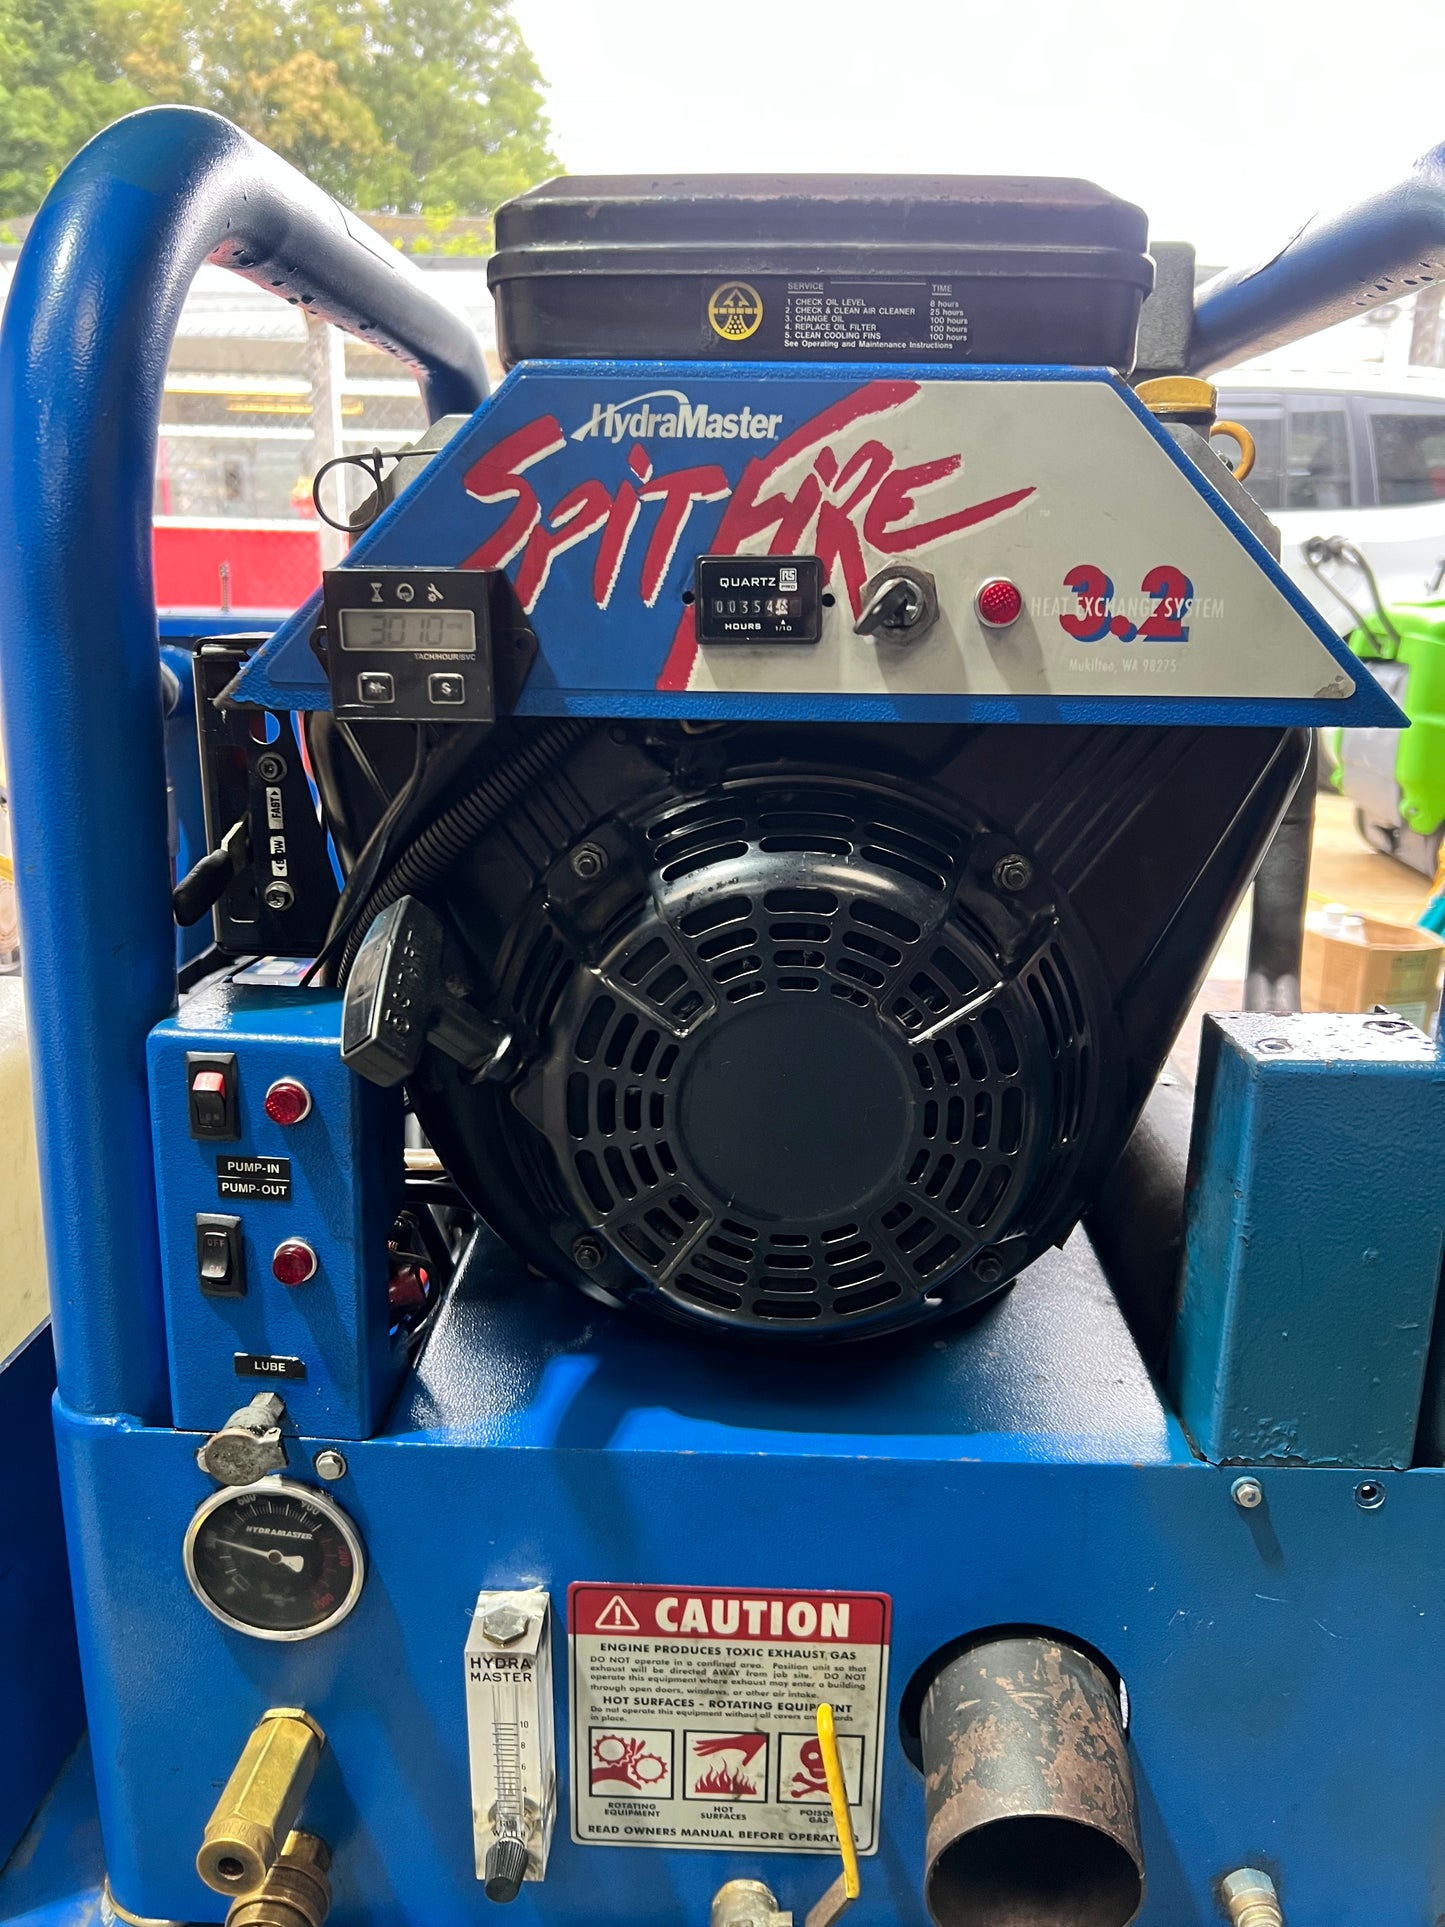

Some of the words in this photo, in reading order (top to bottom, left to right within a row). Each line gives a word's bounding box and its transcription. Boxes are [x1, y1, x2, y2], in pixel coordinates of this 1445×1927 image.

[787, 282, 824, 290] SERVICE
[931, 284, 952, 293] TIME
[795, 298, 823, 306] CHECK
[825, 298, 839, 306] OIL
[929, 300, 935, 308] 8
[937, 300, 959, 308] hours
[833, 307, 860, 315] CLEAN
[863, 307, 876, 315] AIR
[878, 308, 916, 316] CLEANER
[930, 308, 941, 316] 25
[785, 315, 792, 323] 3.
[795, 315, 828, 323] CHANGE
[930, 317, 945, 325] 100
[946, 317, 968, 325] hours
[795, 323, 831, 331] REPLACE
[930, 325, 944, 333] 100
[946, 325, 967, 333] hours
[823, 332, 860, 340] COOLING
[863, 332, 881, 340] FINS
[930, 333, 944, 341] 100
[946, 334, 967, 342] hours
[784, 340, 799, 348] See
[801, 340, 839, 349] Operating
[841, 340, 856, 348] and
[859, 341, 907, 349] Maintenance
[909, 341, 953, 350] Instructions
[588, 400, 783, 444] HydraMaster
[781, 570, 796, 582] RS
[720, 577, 776, 588] QUARTZ
[1031, 597, 1071, 618] HEAT
[1075, 597, 1158, 618] EXCHANGE
[1163, 597, 1225, 618] SYSTEM
[1059, 564, 1194, 643] 3.2
[414, 653, 476, 661] TACH/HOUR/SVC
[1069, 657, 1118, 674] Mukilteo,
[1122, 658, 1139, 673] WA
[1142, 658, 1177, 673] 98275
[270, 797, 281, 819] FAST
[227, 1161, 280, 1174] PUMP-IN
[221, 1182, 287, 1195] PUMP-OUT
[254, 1361, 287, 1373] LUBE
[245, 1526, 314, 1540] HYDRAMASTER
[655, 1597, 850, 1638] CAUTION
[600, 1643, 649, 1652] ENGINE
[654, 1644, 721, 1655] PRODUCES
[726, 1647, 763, 1657] TOXIC
[768, 1648, 826, 1659] EXHAUST
[830, 1651, 856, 1660] GAS
[470, 1657, 532, 1669] HYDRA
[609, 1656, 630, 1664] NOT
[635, 1658, 670, 1667] operate
[674, 1658, 682, 1666] in
[697, 1659, 736, 1668] confined
[773, 1663, 808, 1671] Position
[813, 1663, 830, 1671] unit
[470, 1672, 532, 1682] MASTER
[590, 1664, 625, 1672] exhaust
[670, 1667, 706, 1675] directed
[712, 1668, 740, 1676] AWAY
[746, 1669, 767, 1677] from
[773, 1670, 787, 1679] job
[845, 1673, 866, 1681] NOT
[590, 1673, 625, 1681] operate
[648, 1675, 697, 1684] equipment
[700, 1677, 728, 1685] where
[731, 1678, 766, 1686] exhaust
[769, 1680, 788, 1688] may
[828, 1682, 866, 1691] building
[590, 1683, 626, 1693] through
[655, 1686, 684, 1695] doors,
[687, 1687, 730, 1696] windows,
[746, 1689, 769, 1697] other
[788, 1690, 819, 1699] intake.
[603, 1696, 629, 1704] HOT
[634, 1697, 694, 1707] SURFACES
[709, 1700, 773, 1710] ROTATING
[601, 1715, 627, 1723] place.
[676, 1710, 722, 1718] equipment
[725, 1711, 757, 1719] without
[608, 1802, 656, 1810] ROTATING
[604, 1809, 660, 1817] EQUIPMENT
[701, 1812, 746, 1820] SURFACES
[588, 1825, 619, 1834] READ
[624, 1826, 676, 1836] OWNERS
[681, 1828, 734, 1838] MANUAL
[739, 1831, 784, 1840] BEFORE
